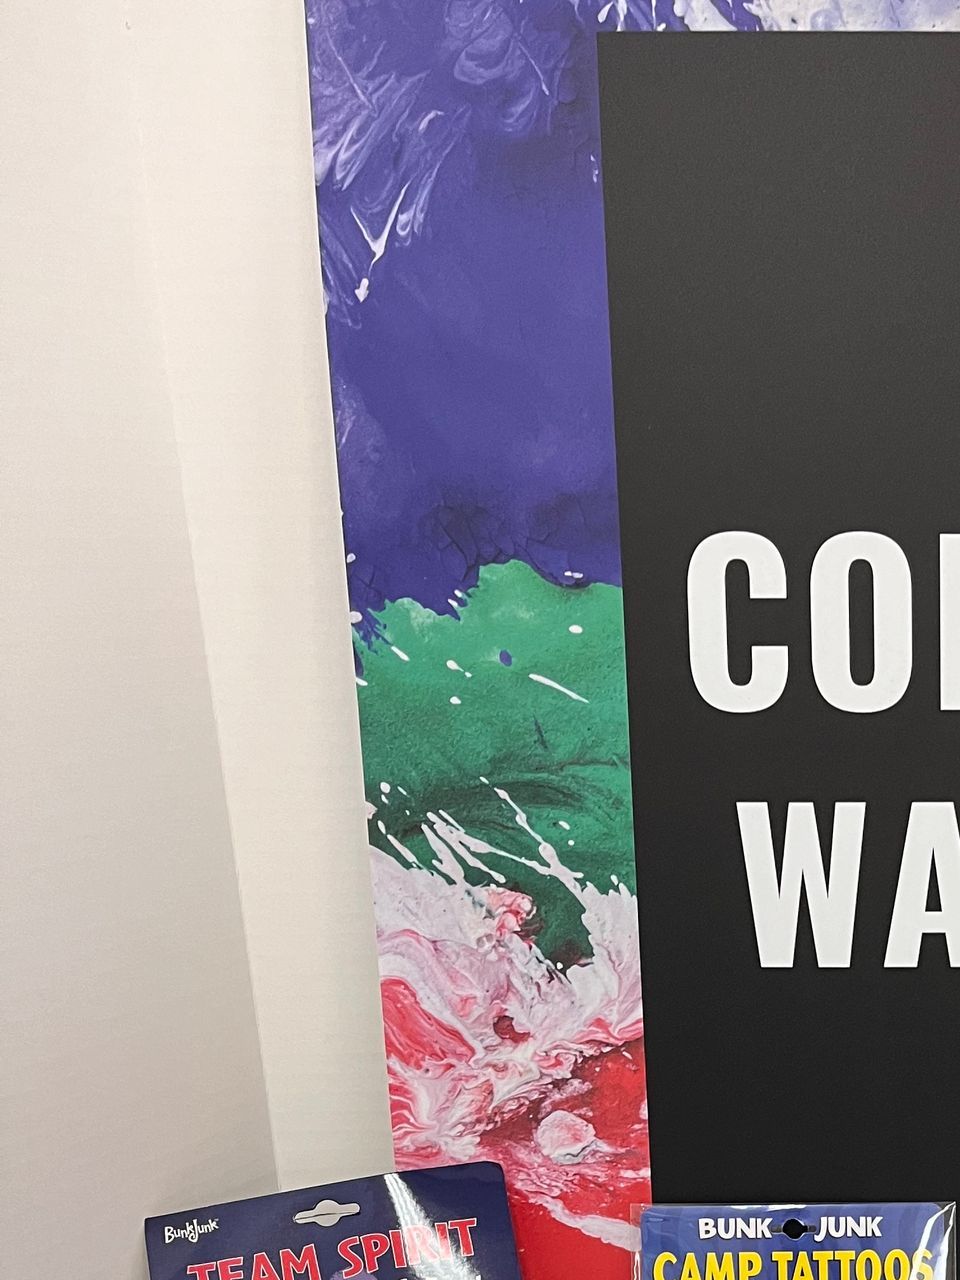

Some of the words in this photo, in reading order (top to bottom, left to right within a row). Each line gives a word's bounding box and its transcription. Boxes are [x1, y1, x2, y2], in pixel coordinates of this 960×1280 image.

[337, 1218, 477, 1279] SPIRIT
[698, 1217, 773, 1239] BUNK
[814, 1216, 883, 1242] JUNK
